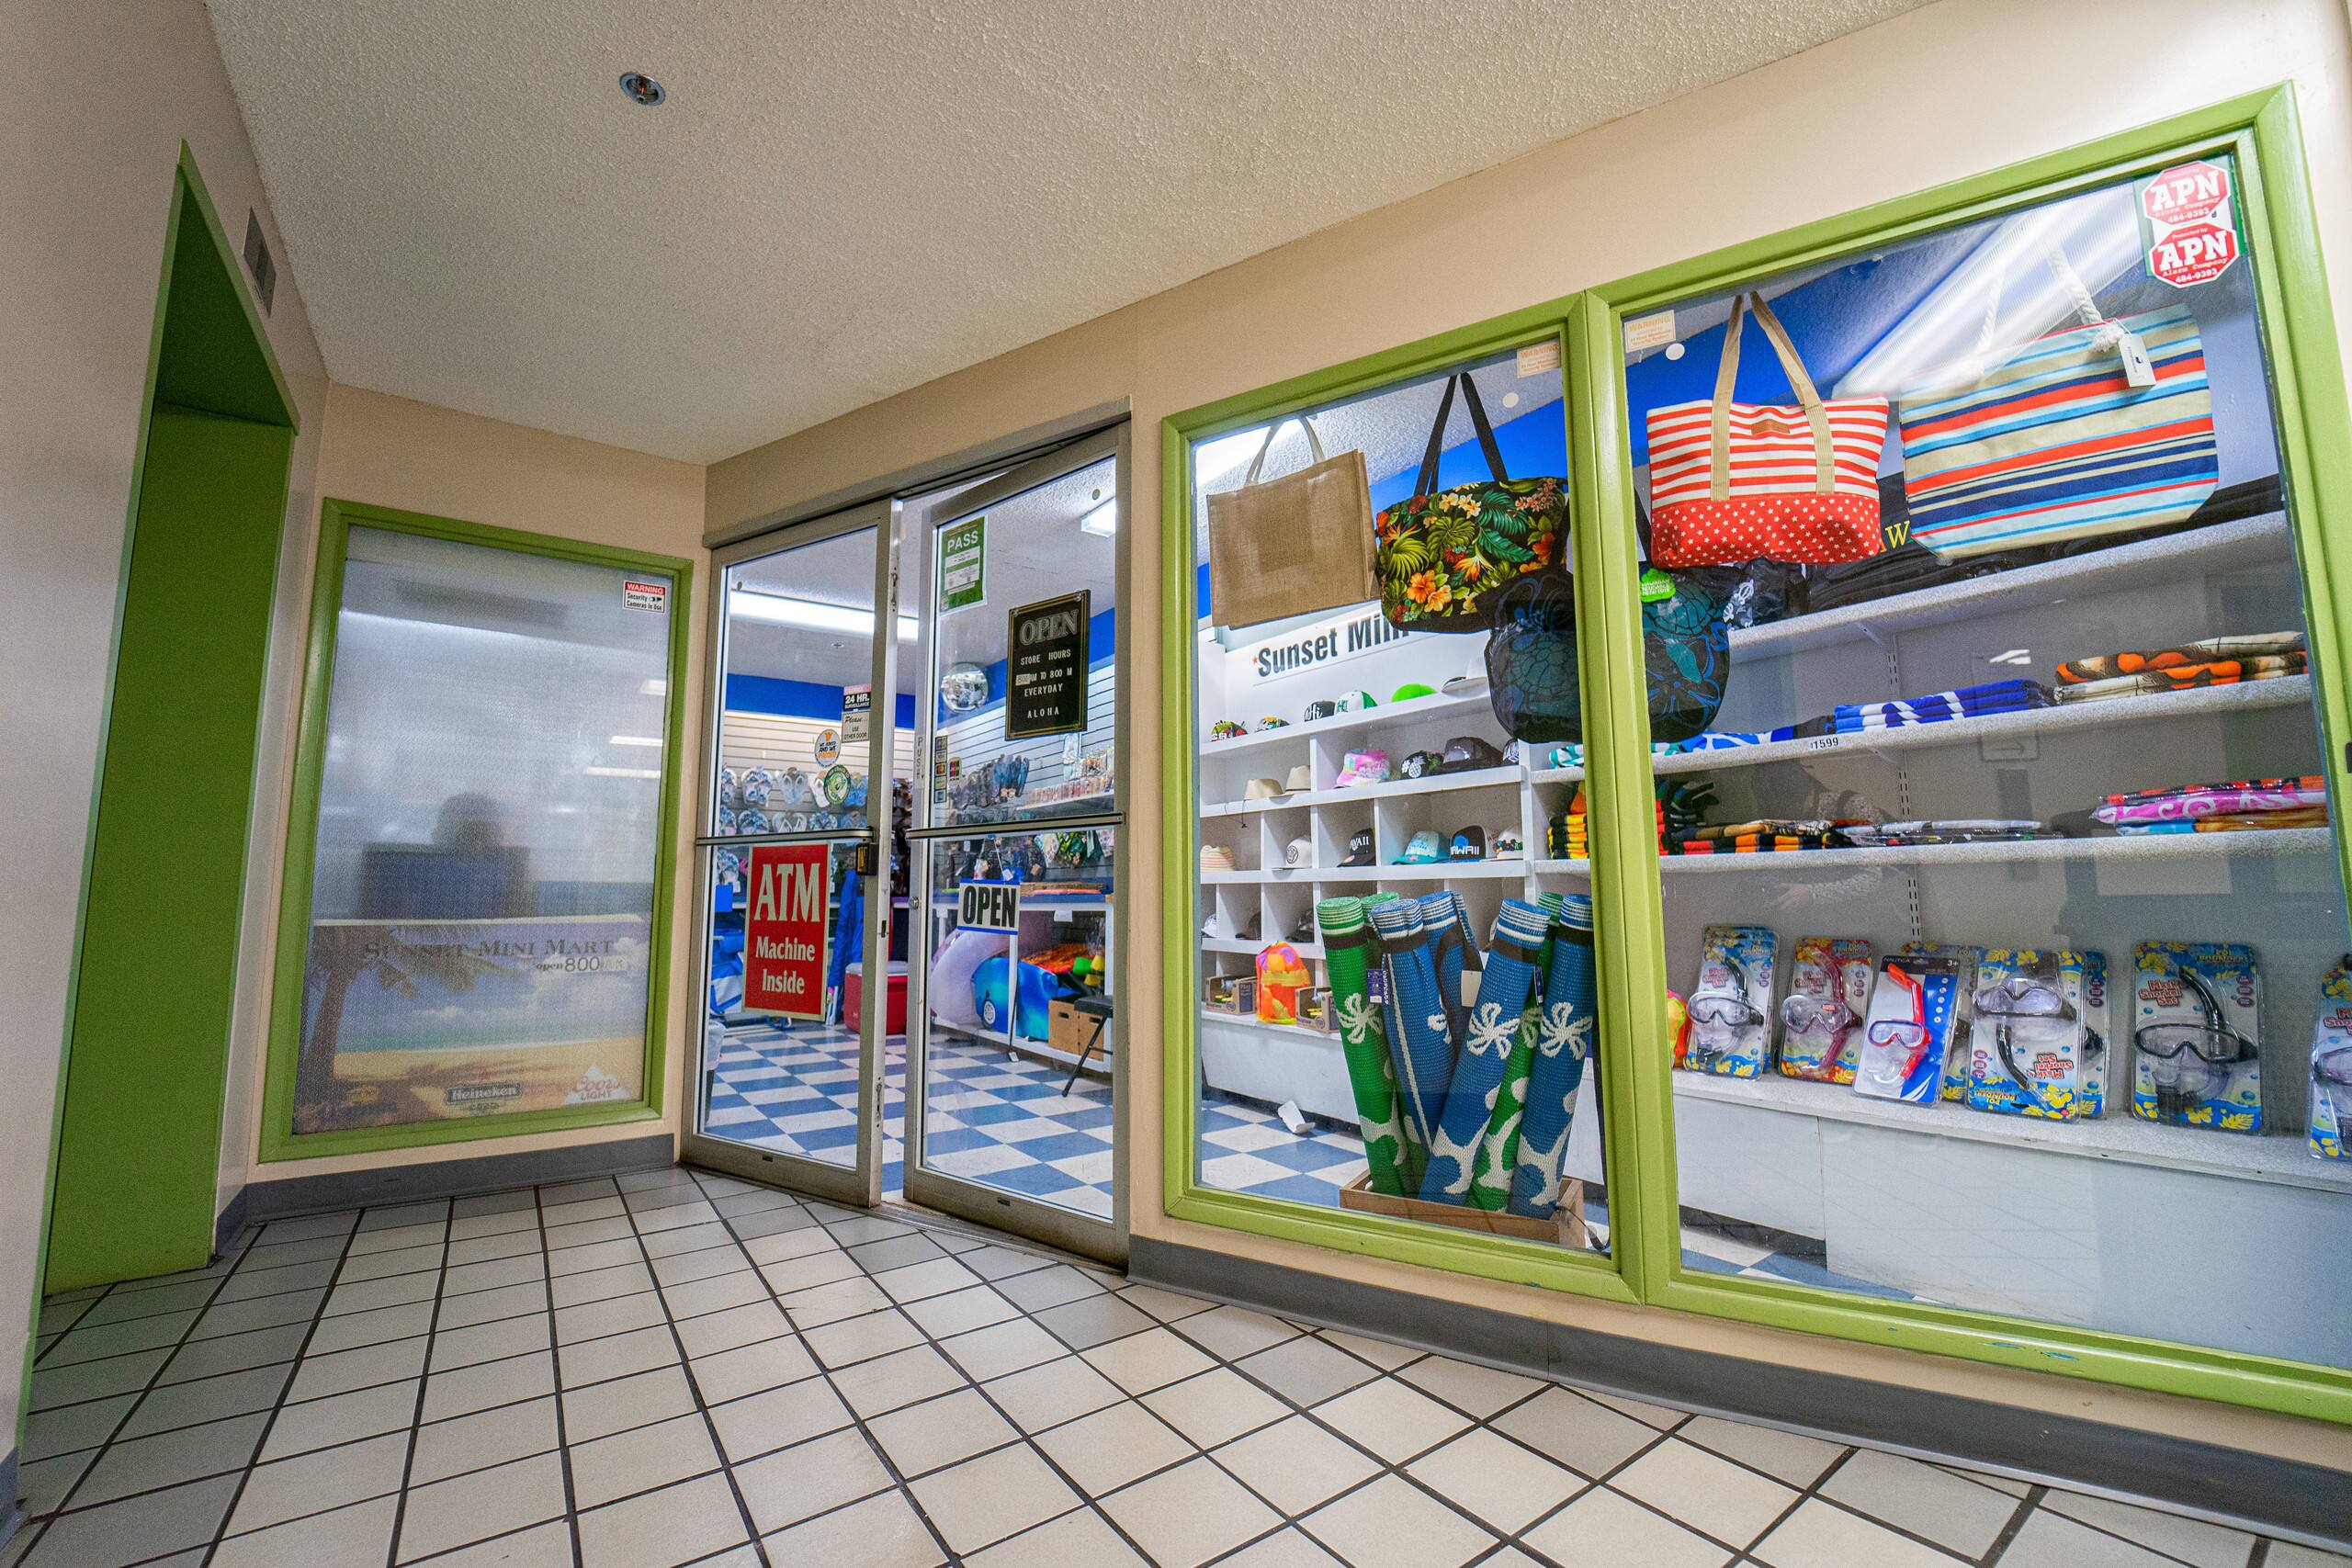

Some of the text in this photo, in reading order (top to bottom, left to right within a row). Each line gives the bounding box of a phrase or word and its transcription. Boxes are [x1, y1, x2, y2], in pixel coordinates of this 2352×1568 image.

[2150, 170, 2220, 212] APN
[2157, 230, 2228, 272] APN
[2192, 257, 2228, 270] Company
[2176, 267, 2218, 284] 484-9393
[1629, 313, 1671, 332] WARNING
[1521, 344, 1559, 358] WARNING
[947, 530, 978, 553] PASS
[627, 582, 663, 594] WARNING
[627, 600, 647, 609] Cameras
[628, 592, 648, 602] Security
[1019, 609, 1079, 646] OPEN
[1258, 613, 1409, 677] Sunset Min
[1021, 649, 1071, 666] STORE HOURS
[1040, 671, 1047, 681] TO
[1024, 682, 1063, 697] EVERYDAY
[845, 693, 870, 705] 24 HR.
[1027, 706, 1059, 719] ALOHA
[754, 863, 820, 922] ATM
[963, 886, 1016, 928] OPEN
[755, 935, 815, 962] Machine
[564, 956, 600, 972] 800
[762, 968, 805, 994] Inside
[2139, 987, 2182, 999] Snorkel
[2157, 997, 2178, 1007] Set
[2035, 1060, 2074, 1071] Snorkel
[2038, 1054, 2057, 1063] Set
[572, 1076, 618, 1093] Coors
[451, 1086, 519, 1100] Heineken
[580, 1090, 612, 1101] LIGHT
